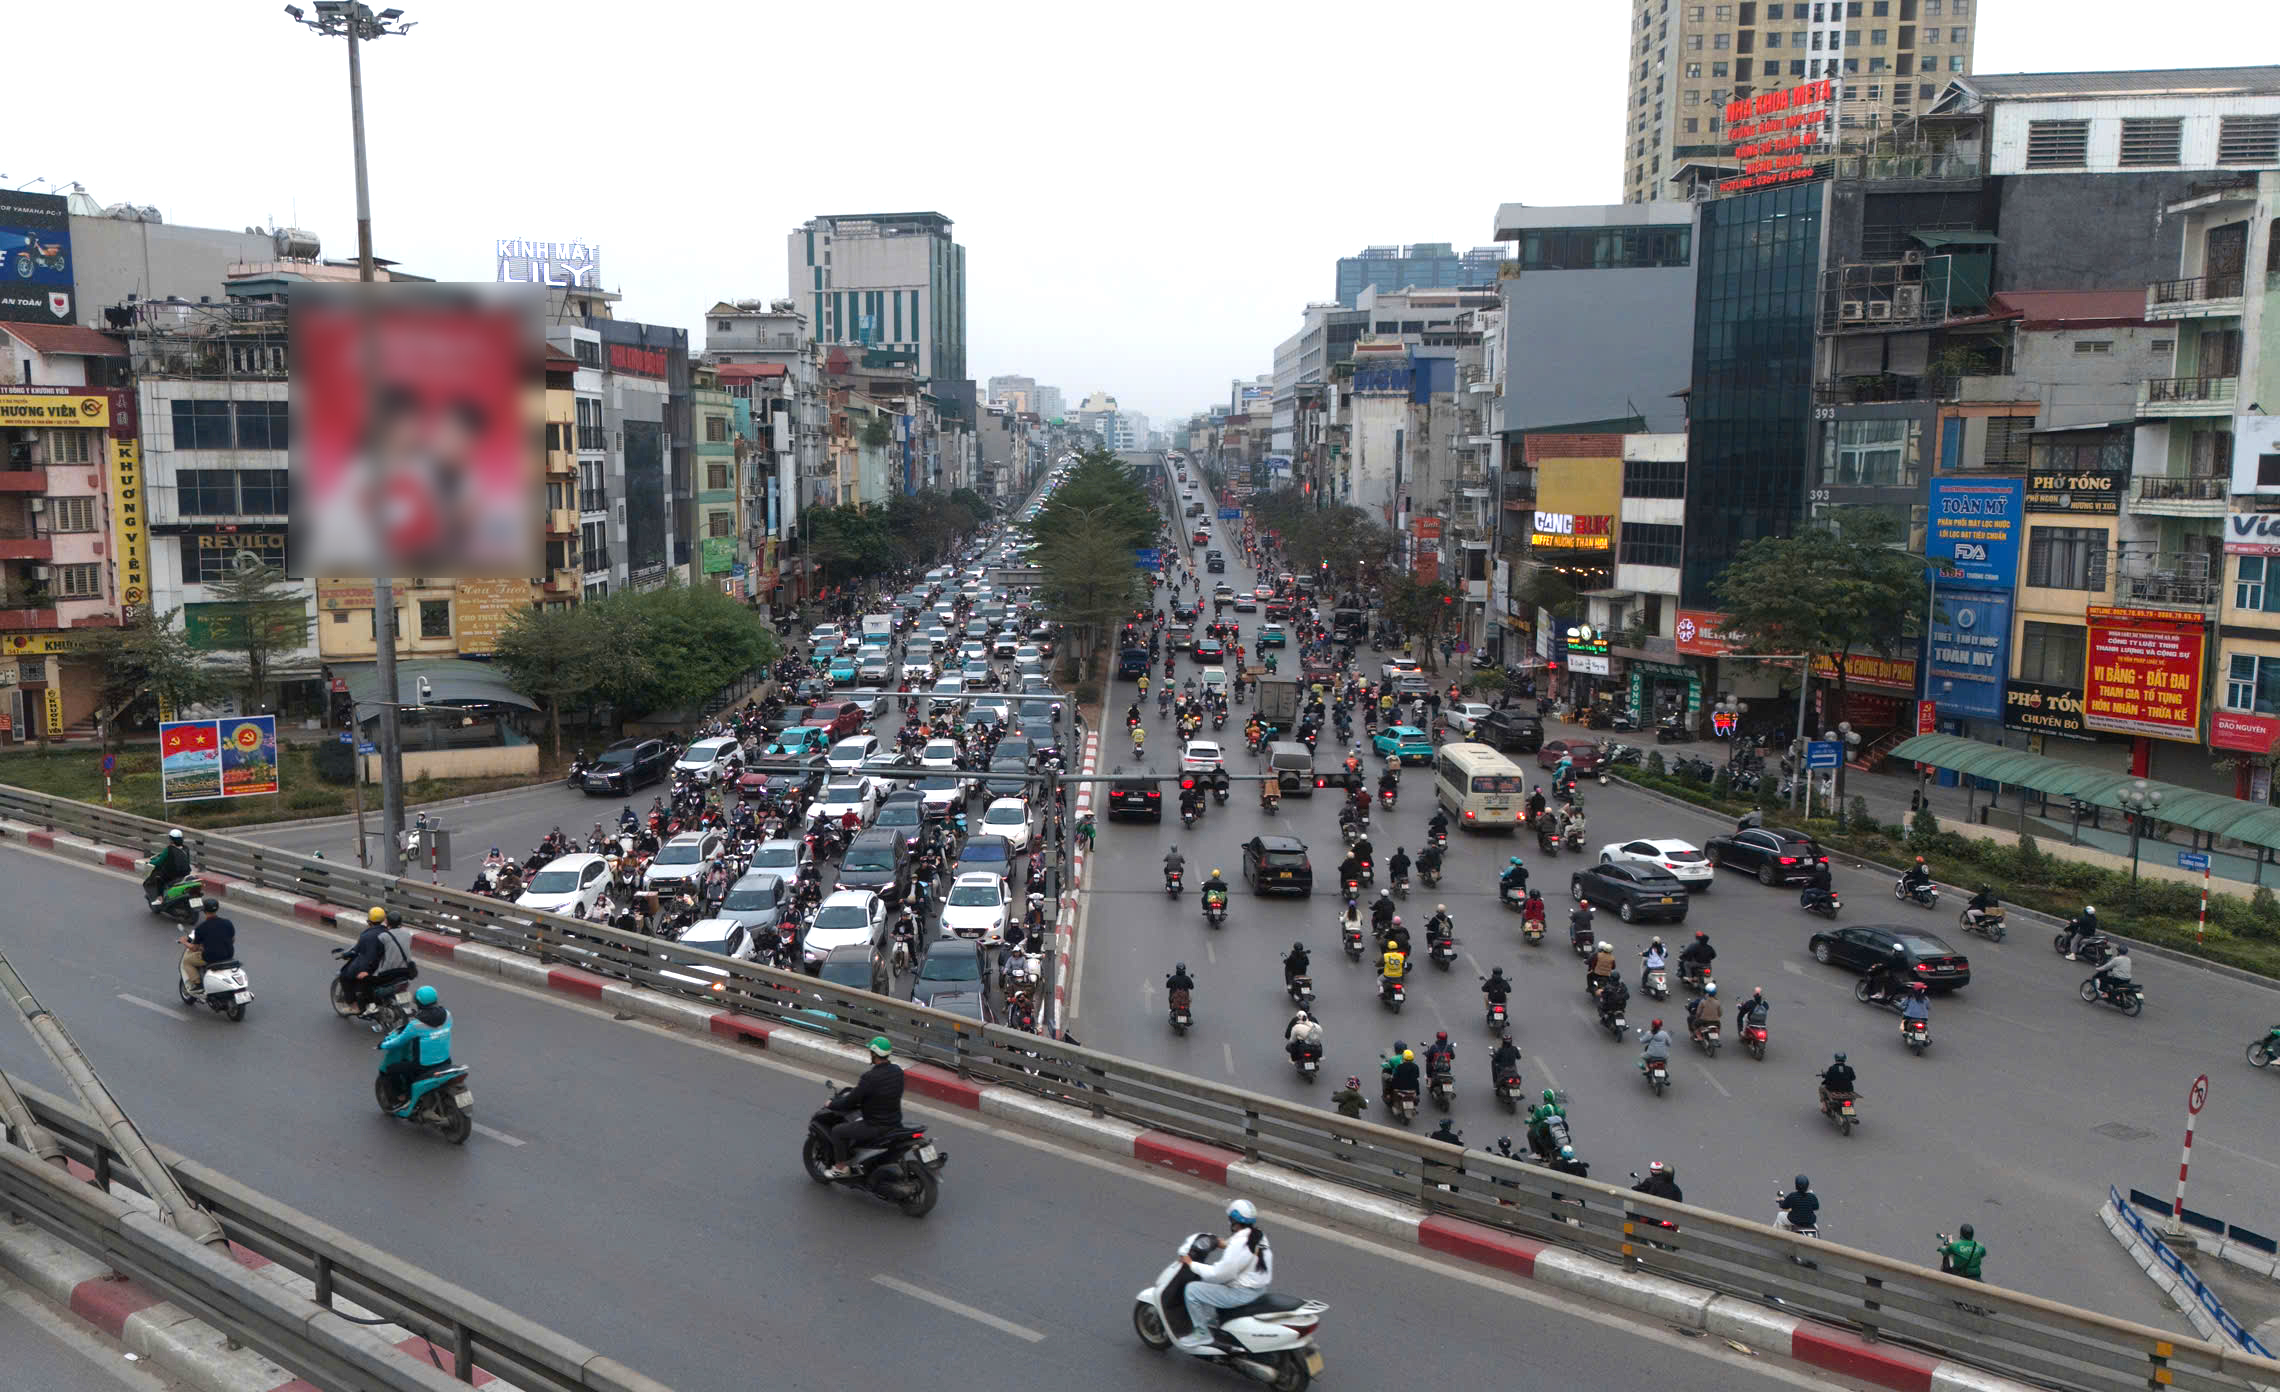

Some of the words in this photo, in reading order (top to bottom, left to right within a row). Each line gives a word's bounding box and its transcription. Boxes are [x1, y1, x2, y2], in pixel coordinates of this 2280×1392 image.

[1726, 98, 1753, 123] NHA
[1756, 89, 1789, 115] KHOA
[1792, 80, 1831, 107] META
[13, 207, 44, 215] YAMAHA
[503, 260, 595, 287] LILY
[48, 404, 77, 417] VIÊN
[1815, 408, 1835, 419] 393
[2033, 472, 2067, 489] PHỞ
[2068, 471, 2112, 490] TỐNG
[1809, 489, 1830, 500] 393
[1942, 494, 1982, 515] TOÀN
[1984, 495, 2009, 515] MỸ
[199, 535, 284, 548] REVILO
[1531, 534, 1554, 546] BUFFET
[1576, 537, 1594, 549] THAN
[1954, 543, 1986, 560] FDA
[2146, 648, 2156, 657] VÀ
[2094, 666, 2105, 681] VI
[2106, 662, 2136, 684] BẰNG
[2147, 667, 2168, 687] ĐẤT
[2170, 672, 2190, 690] ĐAI
[2047, 690, 2083, 713] TỐN
[2099, 685, 2124, 698] THAM
[2125, 688, 2140, 700] GIA
[2157, 691, 2182, 705] TỤNG
[2022, 714, 2062, 728] CHUYÊN
